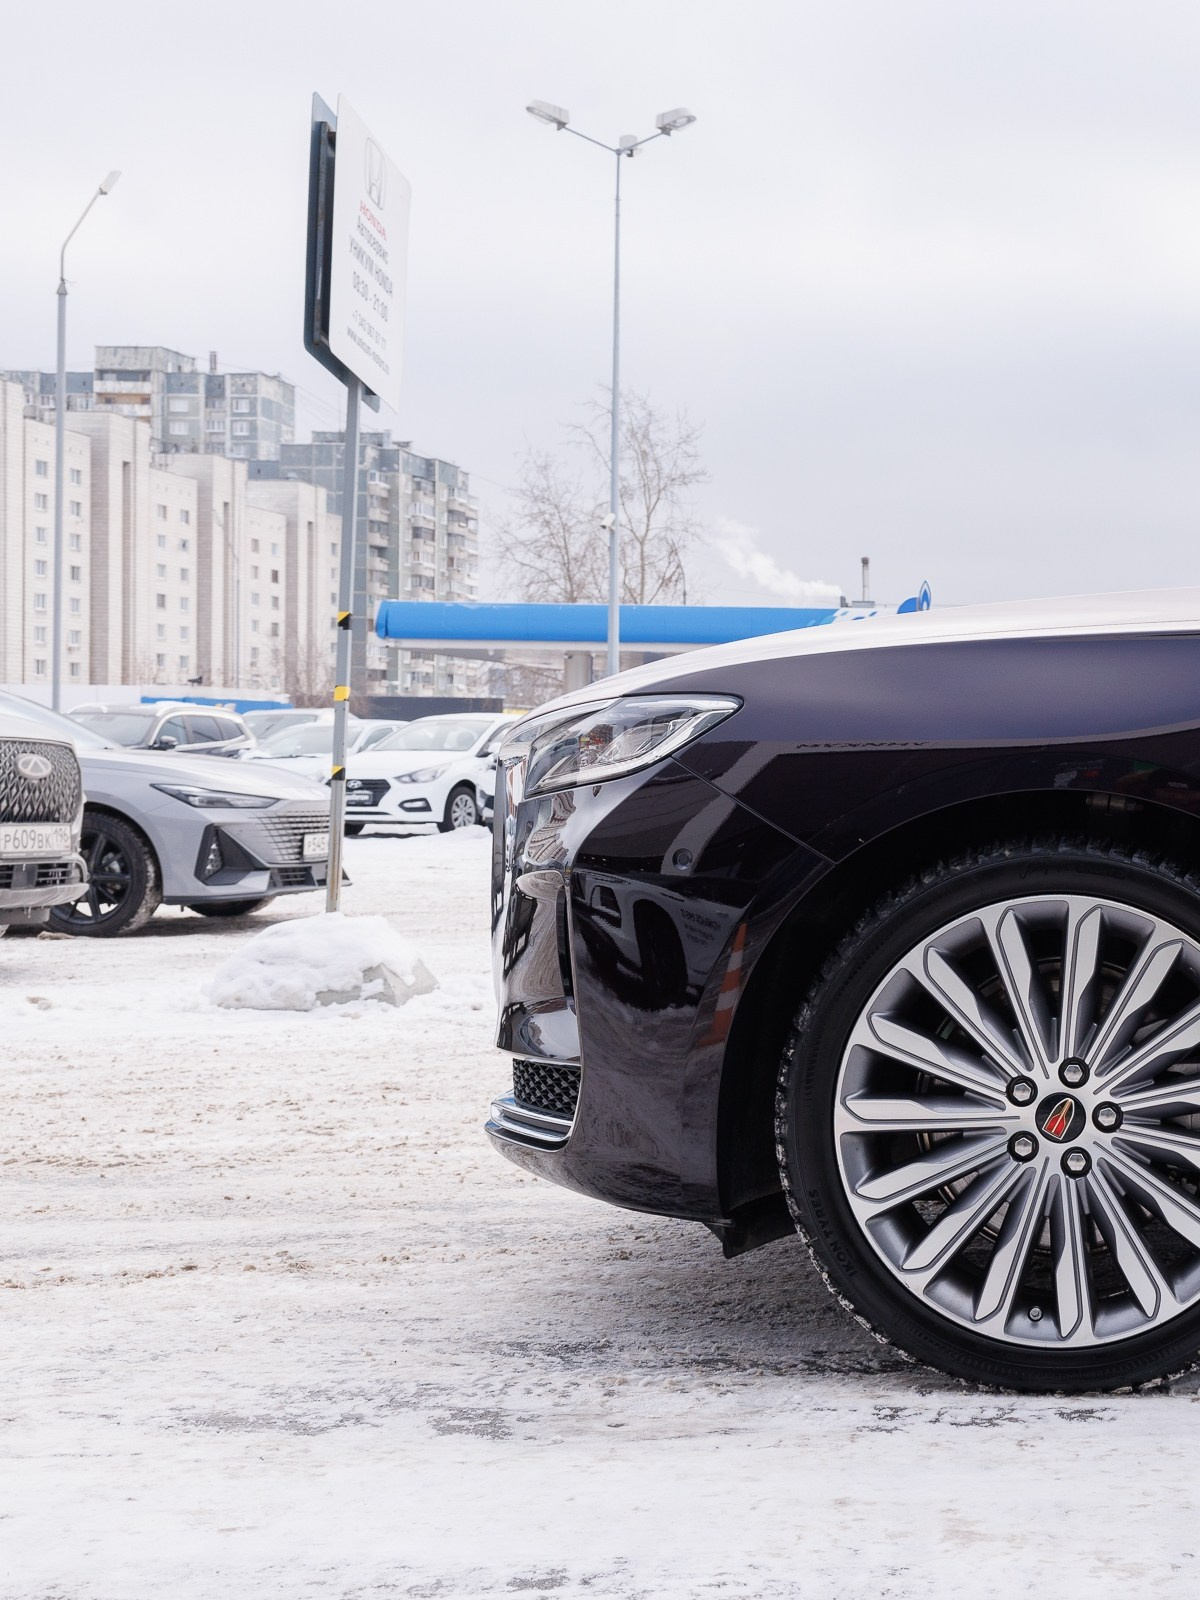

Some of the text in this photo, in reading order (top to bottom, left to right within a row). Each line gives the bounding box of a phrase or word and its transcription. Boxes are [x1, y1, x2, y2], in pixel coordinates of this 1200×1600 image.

[357, 215, 388, 265] Автосервис
[360, 200, 386, 240] HONDA
[349, 233, 392, 299] УНИКУМ HONDA
[373, 293, 388, 322] 21:00
[809, 1189, 857, 1278] IKON TYRES
